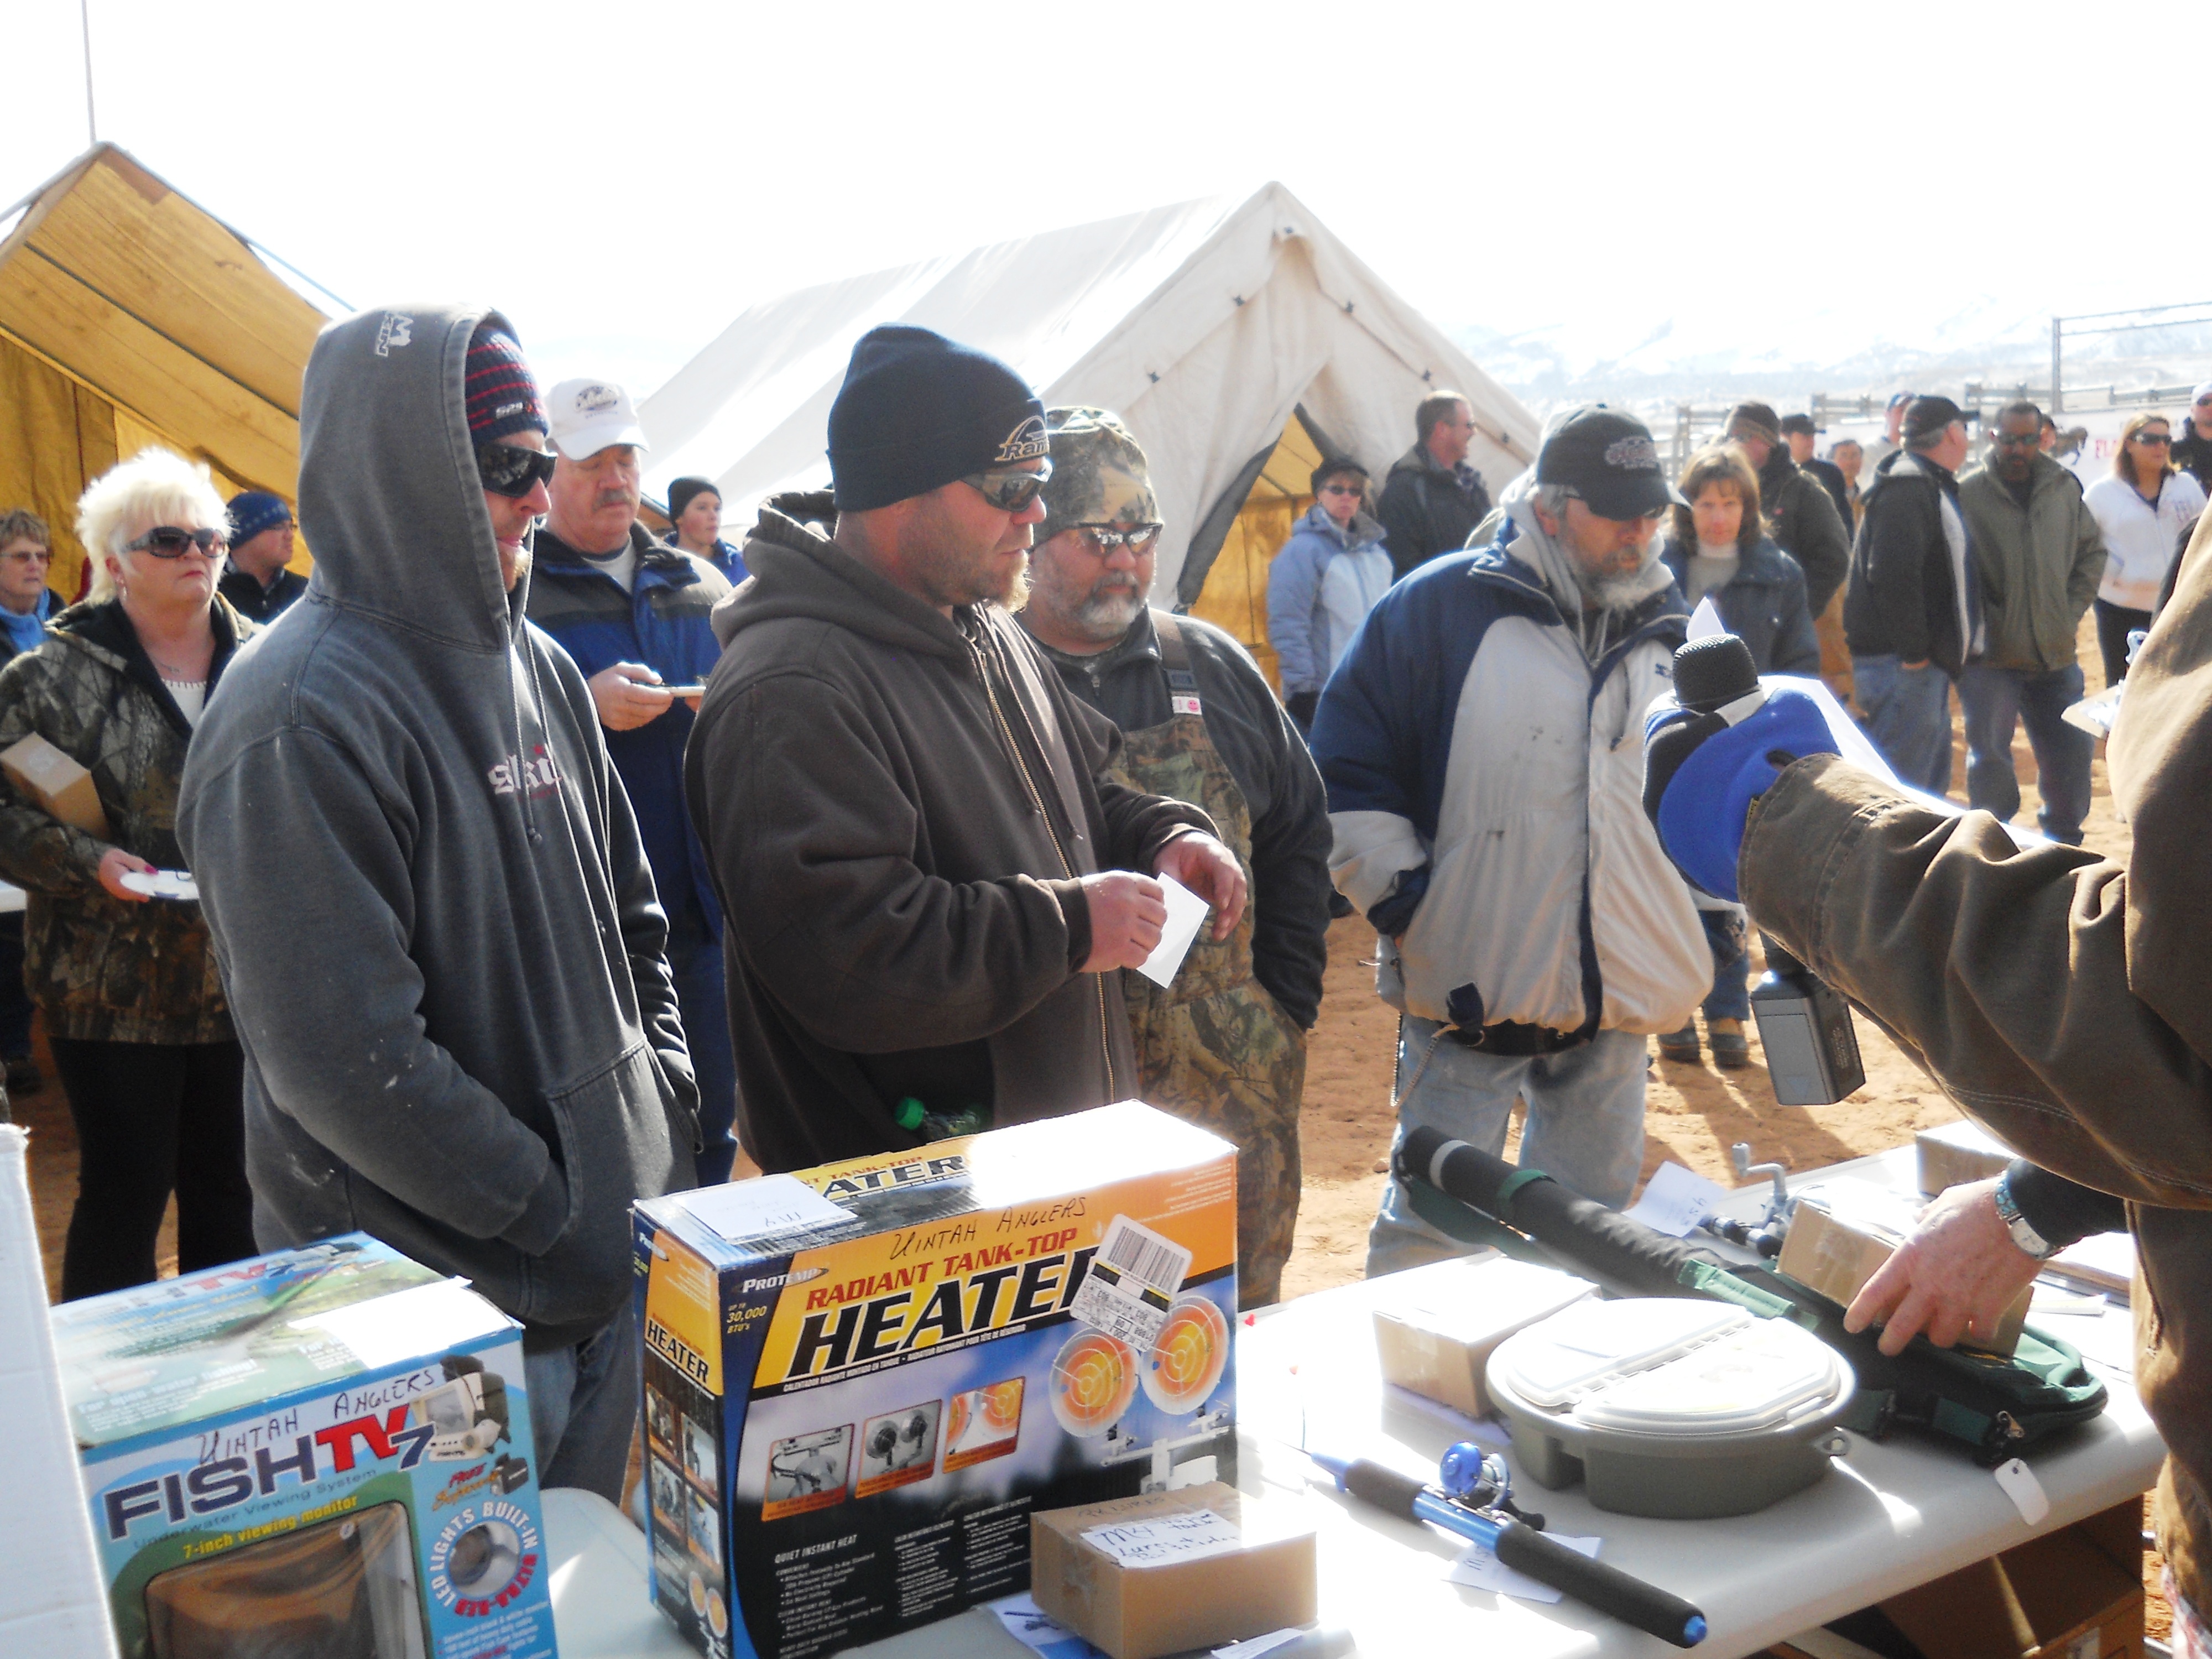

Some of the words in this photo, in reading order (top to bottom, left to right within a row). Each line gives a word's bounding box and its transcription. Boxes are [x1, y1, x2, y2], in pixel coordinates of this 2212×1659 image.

[823, 1155, 966, 1198] ATER
[890, 1218, 978, 1260] UINTAH
[997, 1197, 1086, 1233] ANGLERS
[806, 1261, 933, 1311] RADIANT
[943, 1228, 1078, 1276] TANK-TOP
[727, 1306, 768, 1323] 30,000
[648, 1319, 708, 1383] HEATER
[245, 1490, 310, 1514] Viewing
[317, 1469, 377, 1493] System
[238, 1515, 296, 1542] viewing
[301, 1495, 357, 1522] monitor
[430, 1507, 475, 1572] LIGHTS
[482, 1500, 539, 1550] BUILT-IN
[802, 1541, 837, 1557] INSTANT
[837, 1535, 857, 1548] HEAT
